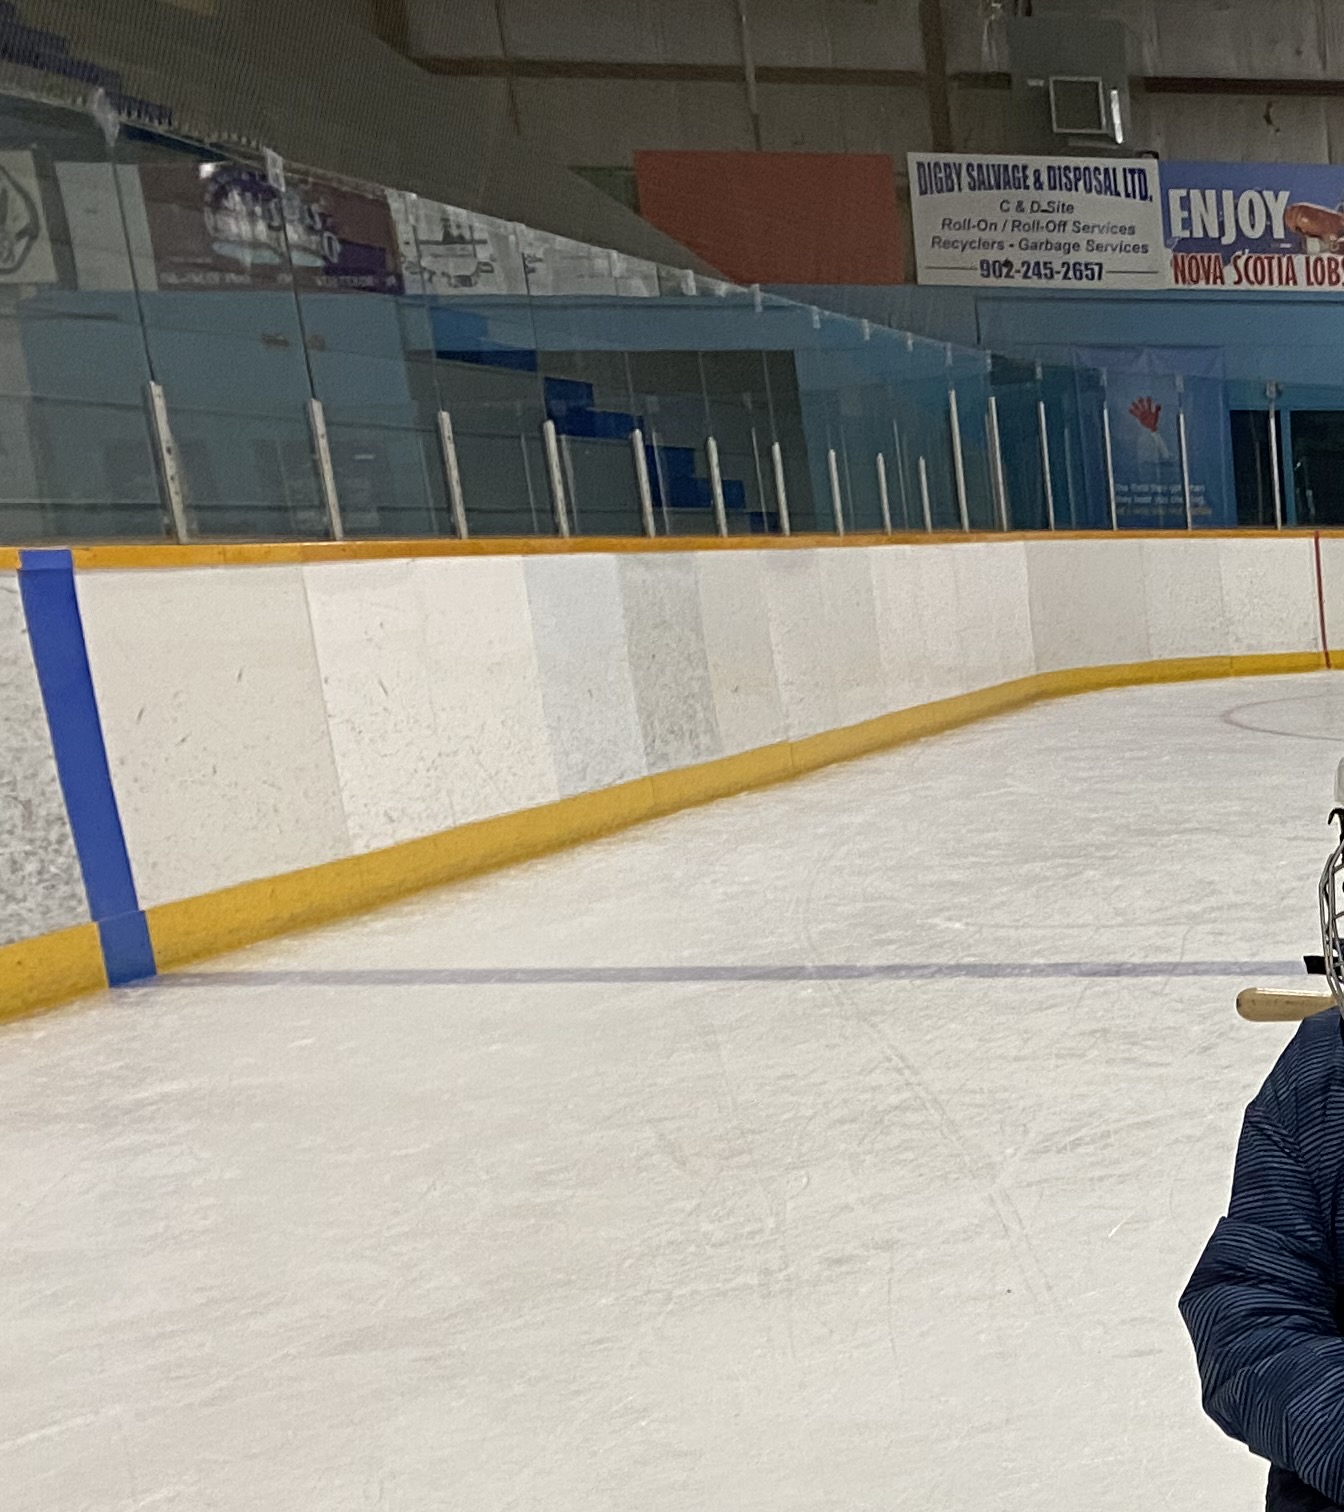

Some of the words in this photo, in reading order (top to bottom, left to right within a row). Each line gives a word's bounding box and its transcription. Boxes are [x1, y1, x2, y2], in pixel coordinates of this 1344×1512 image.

[916, 161, 963, 196] DIGBY
[966, 162, 1030, 193] SALVAGE
[1033, 168, 1043, 190] &
[1047, 164, 1121, 198] DISPOSAL
[1123, 167, 1153, 202] LTD.
[1000, 200, 1010, 212] C
[1015, 201, 1025, 212] &
[1168, 188, 1290, 245] ENJOY
[941, 218, 997, 232] Roll-On
[1011, 219, 1067, 234] Roll-Off
[1072, 221, 1136, 235] Services
[931, 236, 1004, 252] Recyclers
[1018, 237, 1081, 255] Garbage
[1086, 239, 1149, 254] Services
[979, 258, 1104, 281] 902-245-2657
[1173, 253, 1225, 286] NOVA
[1234, 255, 1297, 287] SCOTIA
